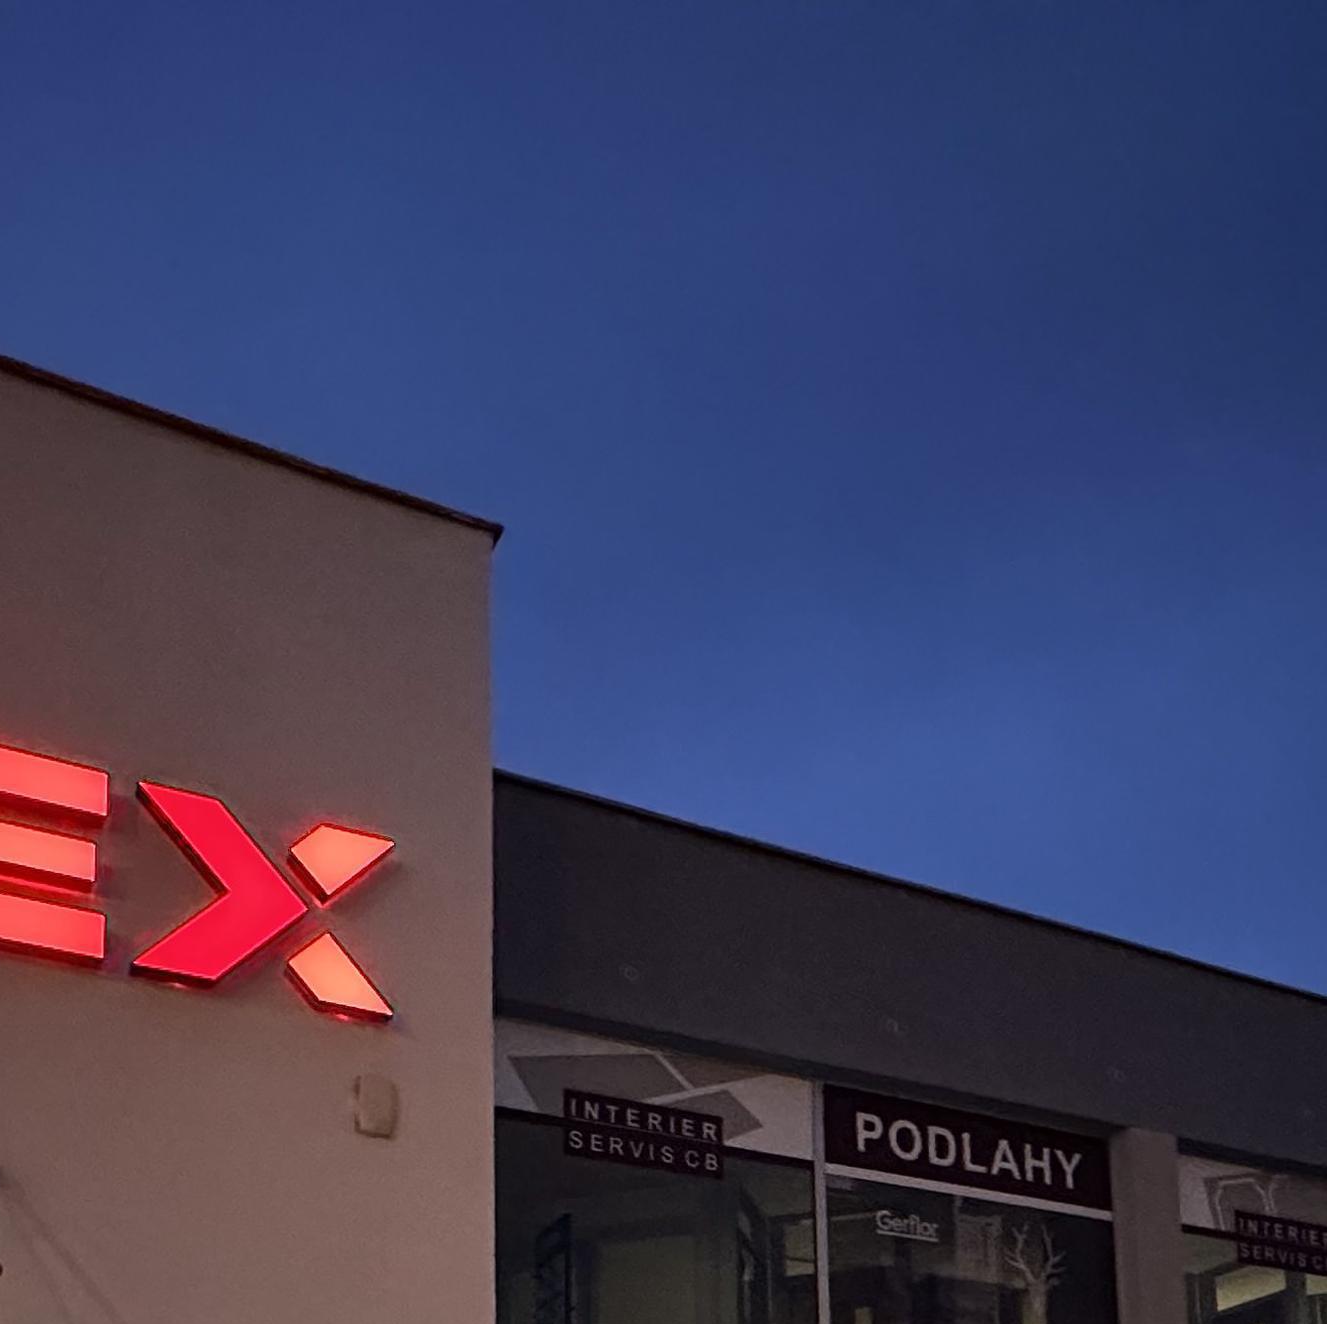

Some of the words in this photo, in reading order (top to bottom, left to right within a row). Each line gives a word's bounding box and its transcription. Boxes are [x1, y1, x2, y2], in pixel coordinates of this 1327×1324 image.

[568, 1098, 719, 1141] INTERIER
[569, 1130, 675, 1164] SERVIS
[684, 1148, 719, 1173] CB
[856, 1112, 1082, 1190] PODLAHY
[875, 1210, 939, 1238] Gerflor
[1239, 1243, 1308, 1268] SERVIS
